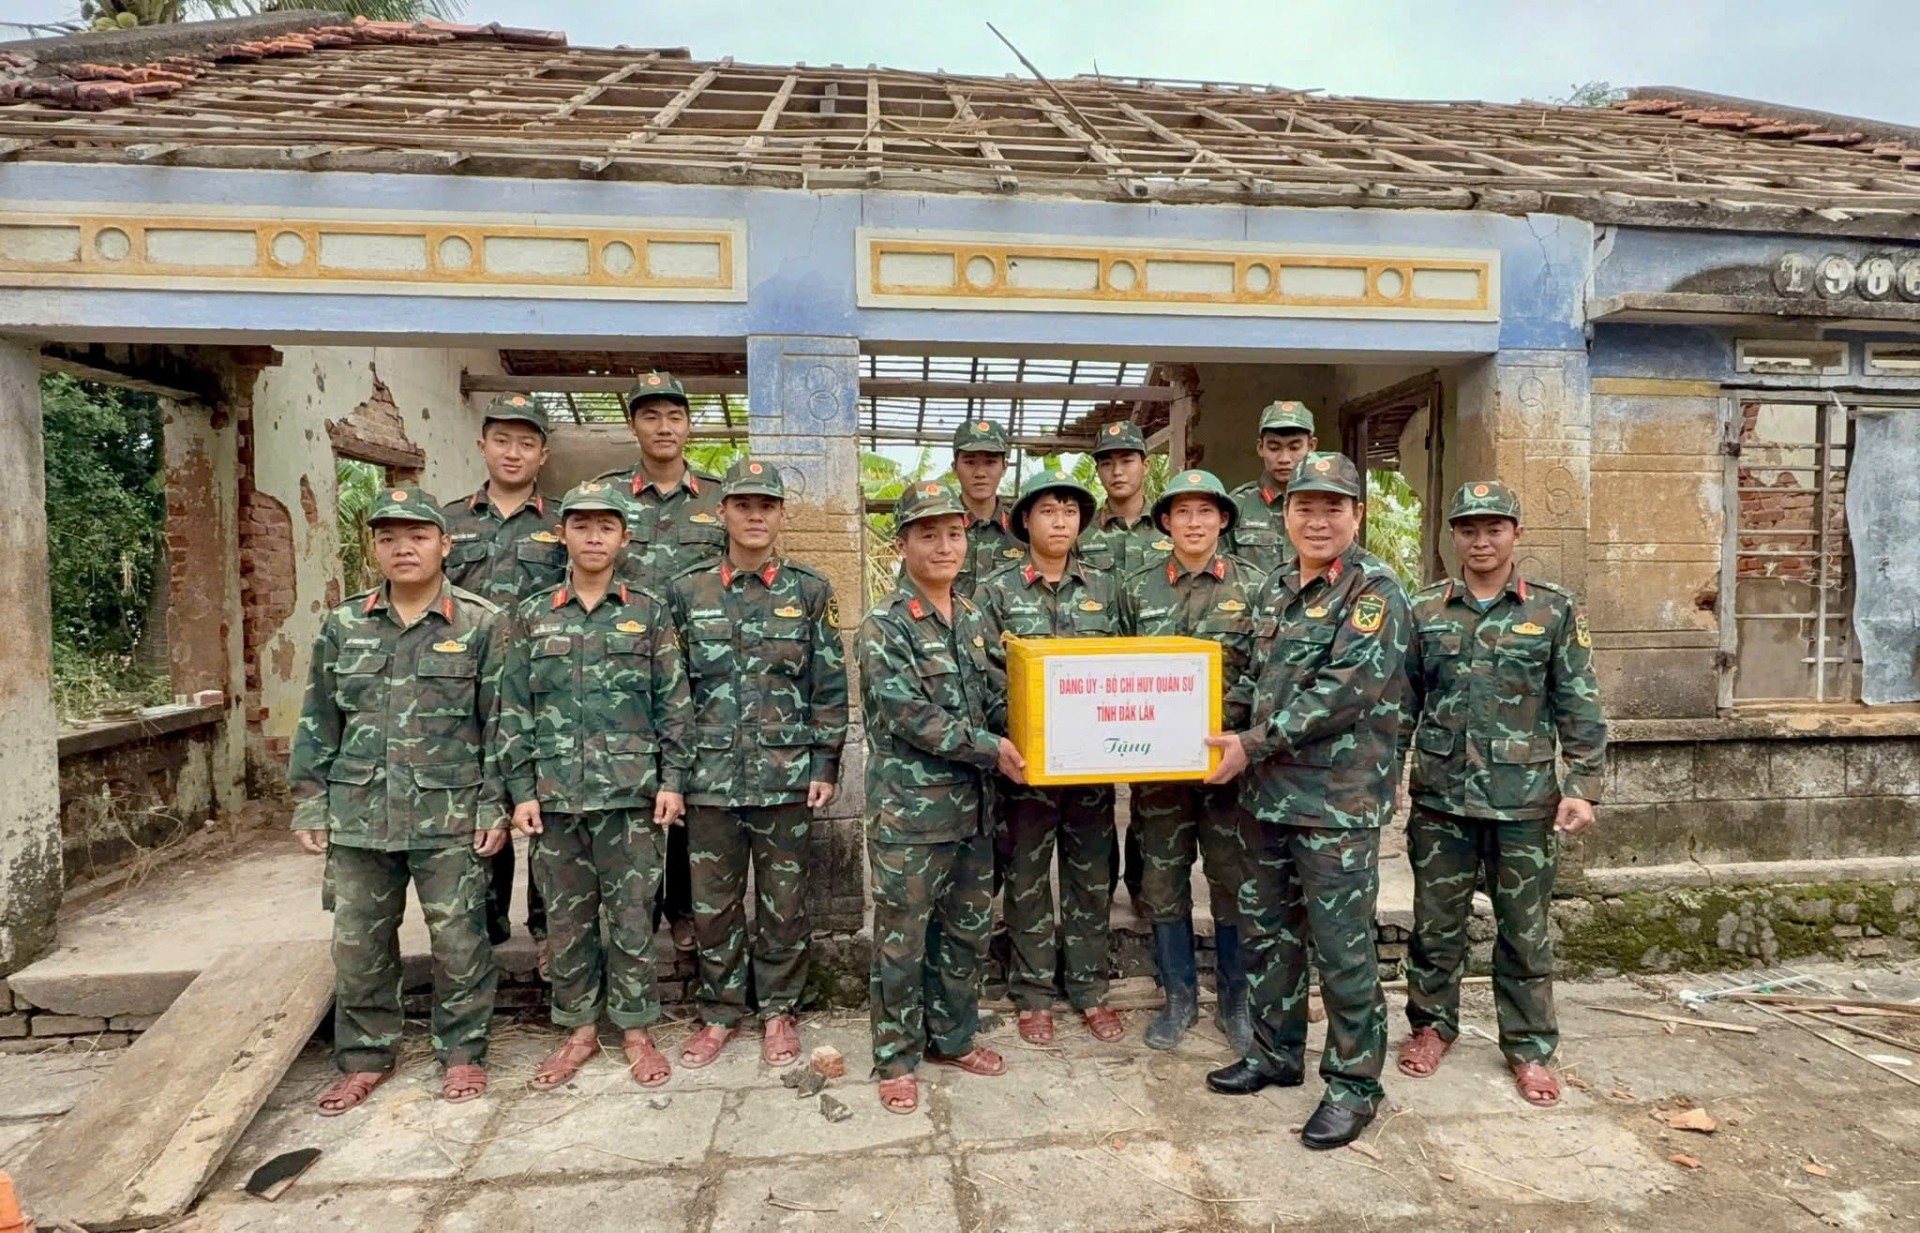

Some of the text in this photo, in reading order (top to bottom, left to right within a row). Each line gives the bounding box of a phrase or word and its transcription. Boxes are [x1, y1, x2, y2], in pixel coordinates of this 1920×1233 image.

[1105, 674, 1118, 696] BỘ
[1137, 676, 1154, 693] HUY
[1156, 673, 1180, 694] QUÂN
[1182, 675, 1195, 696] SỰ
[1104, 737, 1151, 757] Tặng
